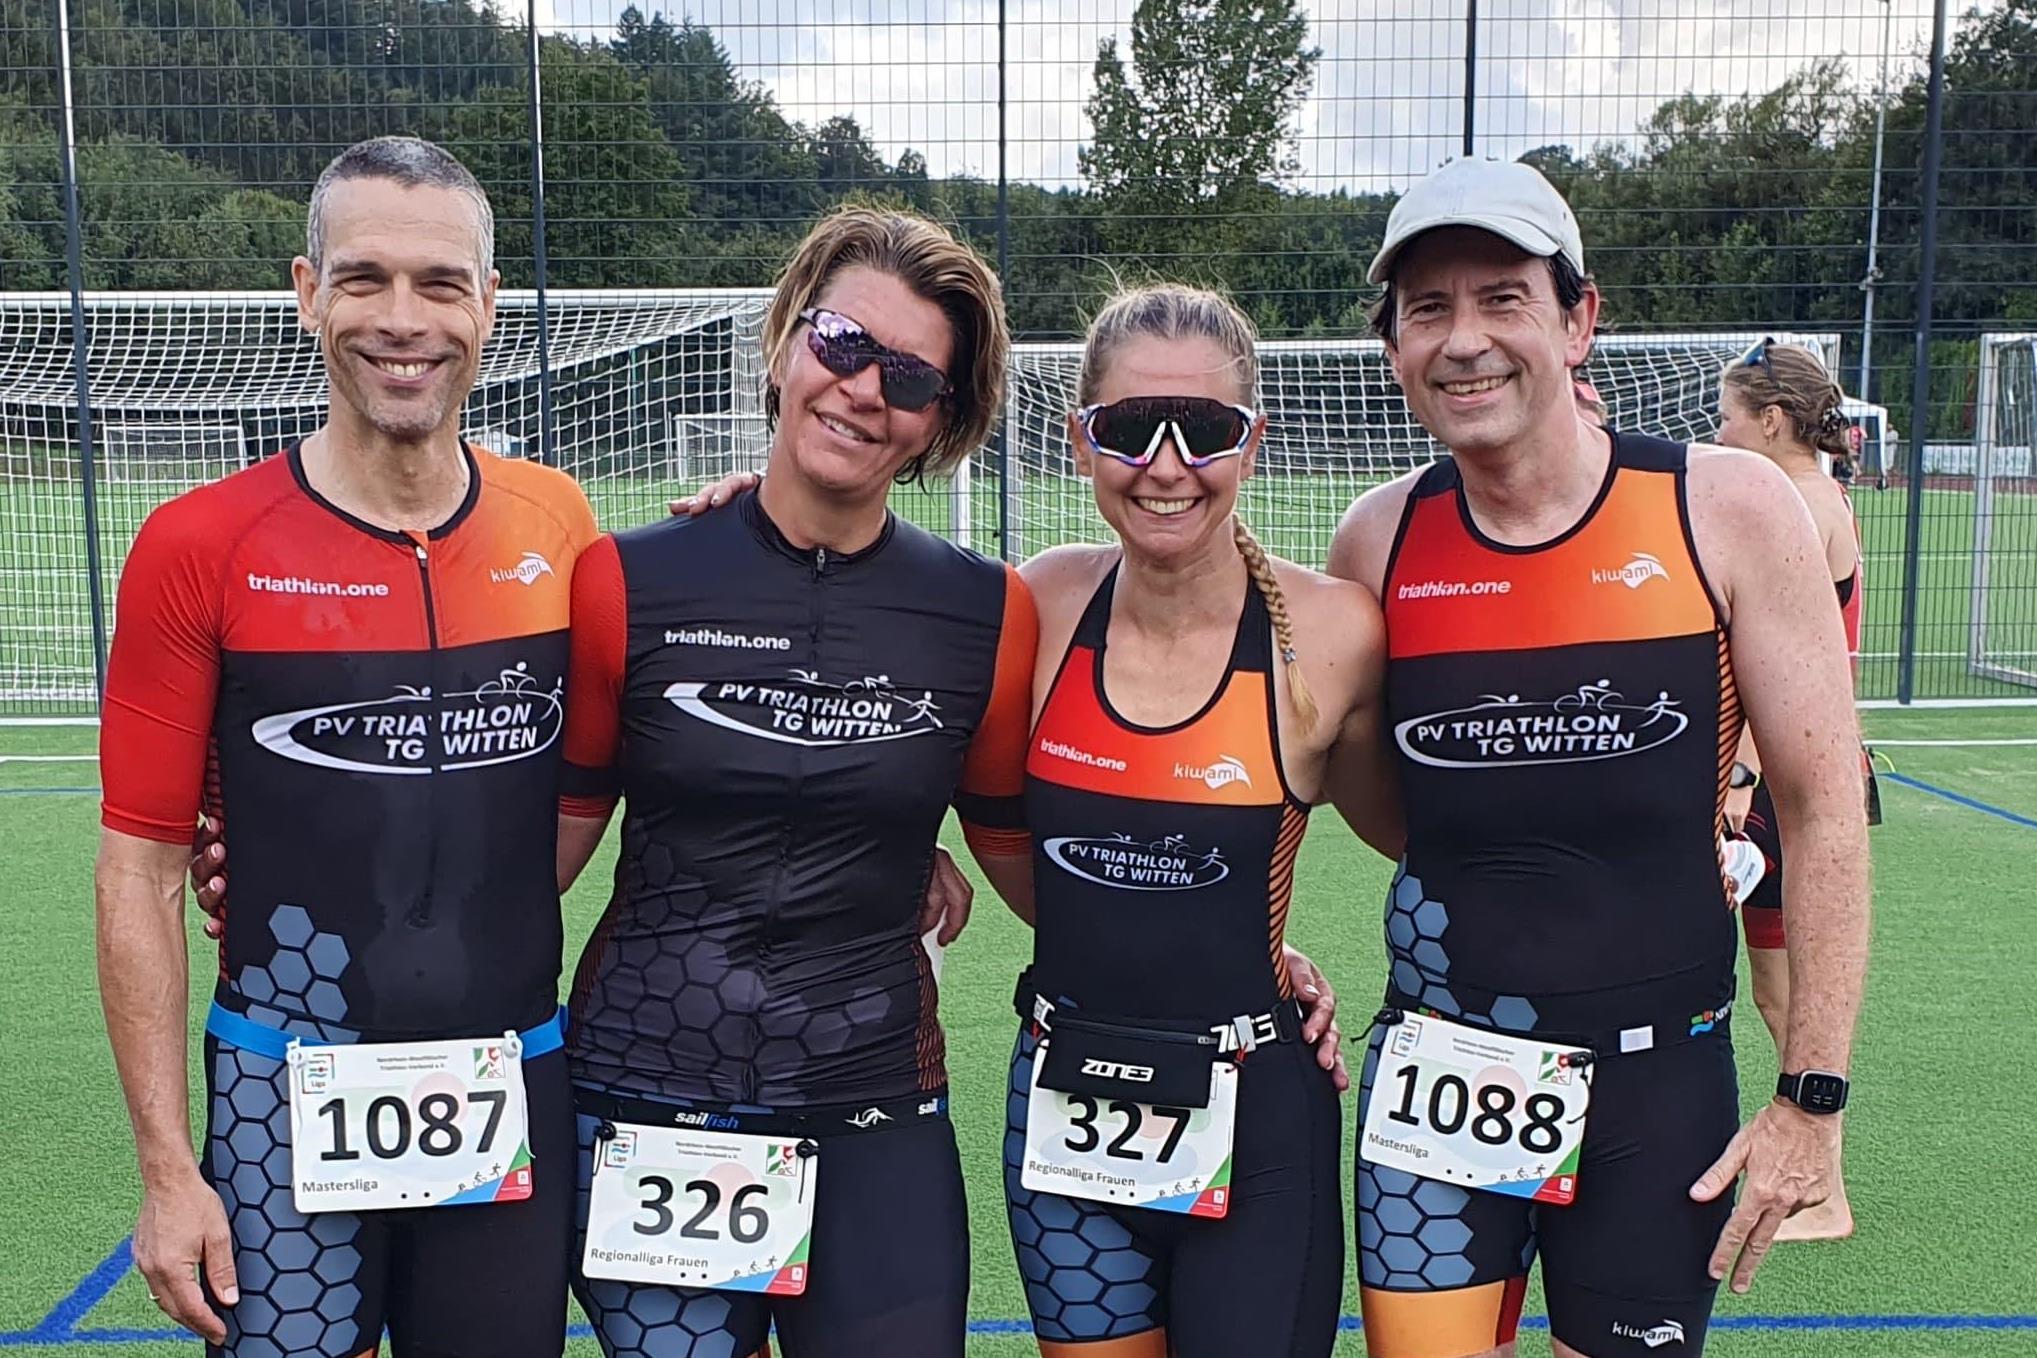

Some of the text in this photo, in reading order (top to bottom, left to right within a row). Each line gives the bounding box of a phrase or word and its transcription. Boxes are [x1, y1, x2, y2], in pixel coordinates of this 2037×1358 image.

[490, 558, 547, 584] kiwami
[1591, 560, 1658, 586] kiwami
[247, 573, 389, 596] triathlon.one
[1397, 579, 1512, 600] triathlon.one
[664, 629, 791, 650] triathlon.one
[718, 683, 892, 721] PV TRIATHLON
[313, 716, 356, 736] PV
[772, 709, 901, 738] TG WITTEN
[1416, 714, 1621, 742] PV TRIATHLON
[385, 726, 538, 760] TG WITTEN
[1040, 738, 1127, 772] triathlon.one
[1477, 732, 1636, 756] TG WITTEN
[1173, 760, 1242, 784] kiwami
[1069, 843, 1187, 871] PV TRIATHLON
[1104, 863, 1195, 885] TG WITTEN
[1080, 1057, 1155, 1083] ZONE3
[674, 1111, 740, 1130] sailfish
[1387, 1063, 1566, 1155] 1088
[318, 1089, 507, 1161] 1087
[1064, 1095, 1192, 1164] 327
[1367, 1132, 1429, 1159] Mastersliga
[302, 1179, 379, 1193] Mastersliga
[1028, 1160, 1136, 1187] Regionalliga Frauen
[632, 1174, 770, 1245] 326
[590, 1248, 709, 1269] Regionalliga Frauen
[1612, 1320, 1679, 1343] kiwami
